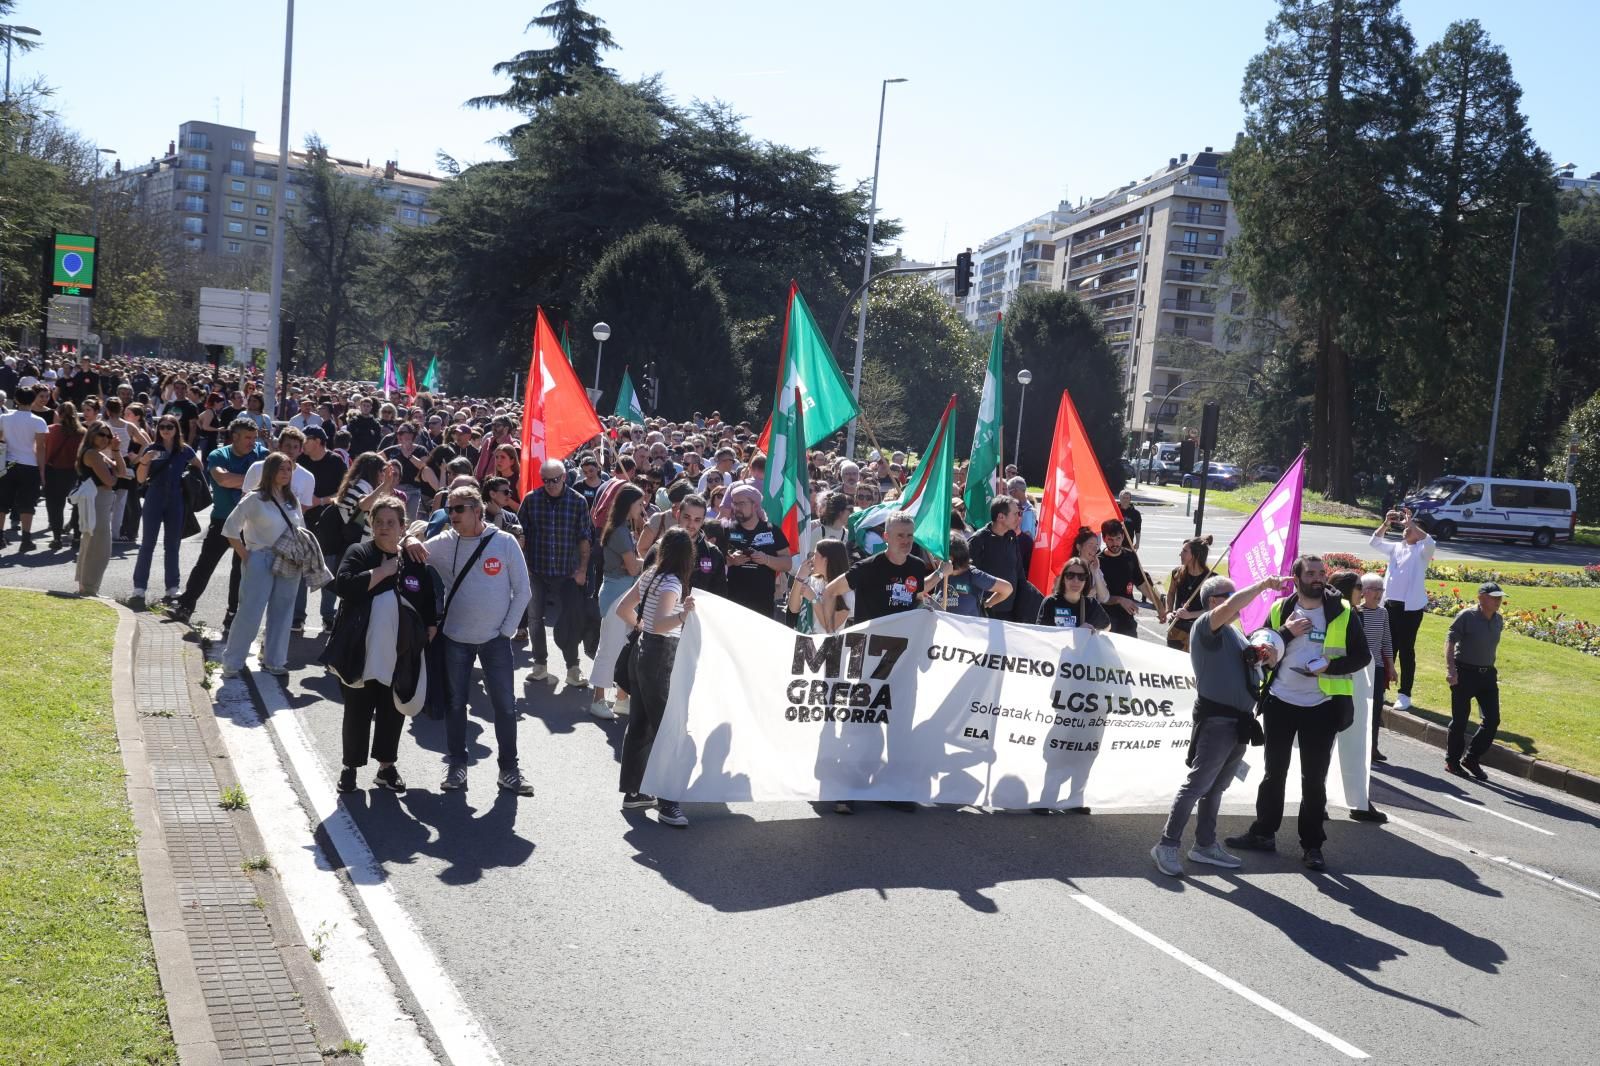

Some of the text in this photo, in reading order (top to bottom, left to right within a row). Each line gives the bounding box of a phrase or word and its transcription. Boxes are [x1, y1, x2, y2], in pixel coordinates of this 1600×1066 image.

[484, 561, 500, 569] LAB
[405, 578, 418, 586] LAB
[1055, 608, 1070, 616] ELA
[1310, 632, 1325, 640] ELA
[791, 633, 909, 680] M17
[927, 645, 1197, 690] GUTXIENEKO SOLDATA HEMEN
[786, 679, 892, 710] GREBA
[784, 706, 890, 724] OROKORRA
[970, 701, 1196, 729] Soldatak hobetu, aberastasuna bana
[1104, 695, 1176, 717] 1.500€
[963, 727, 1191, 752] ELA LAB STEILAS ETXALDE HIR
